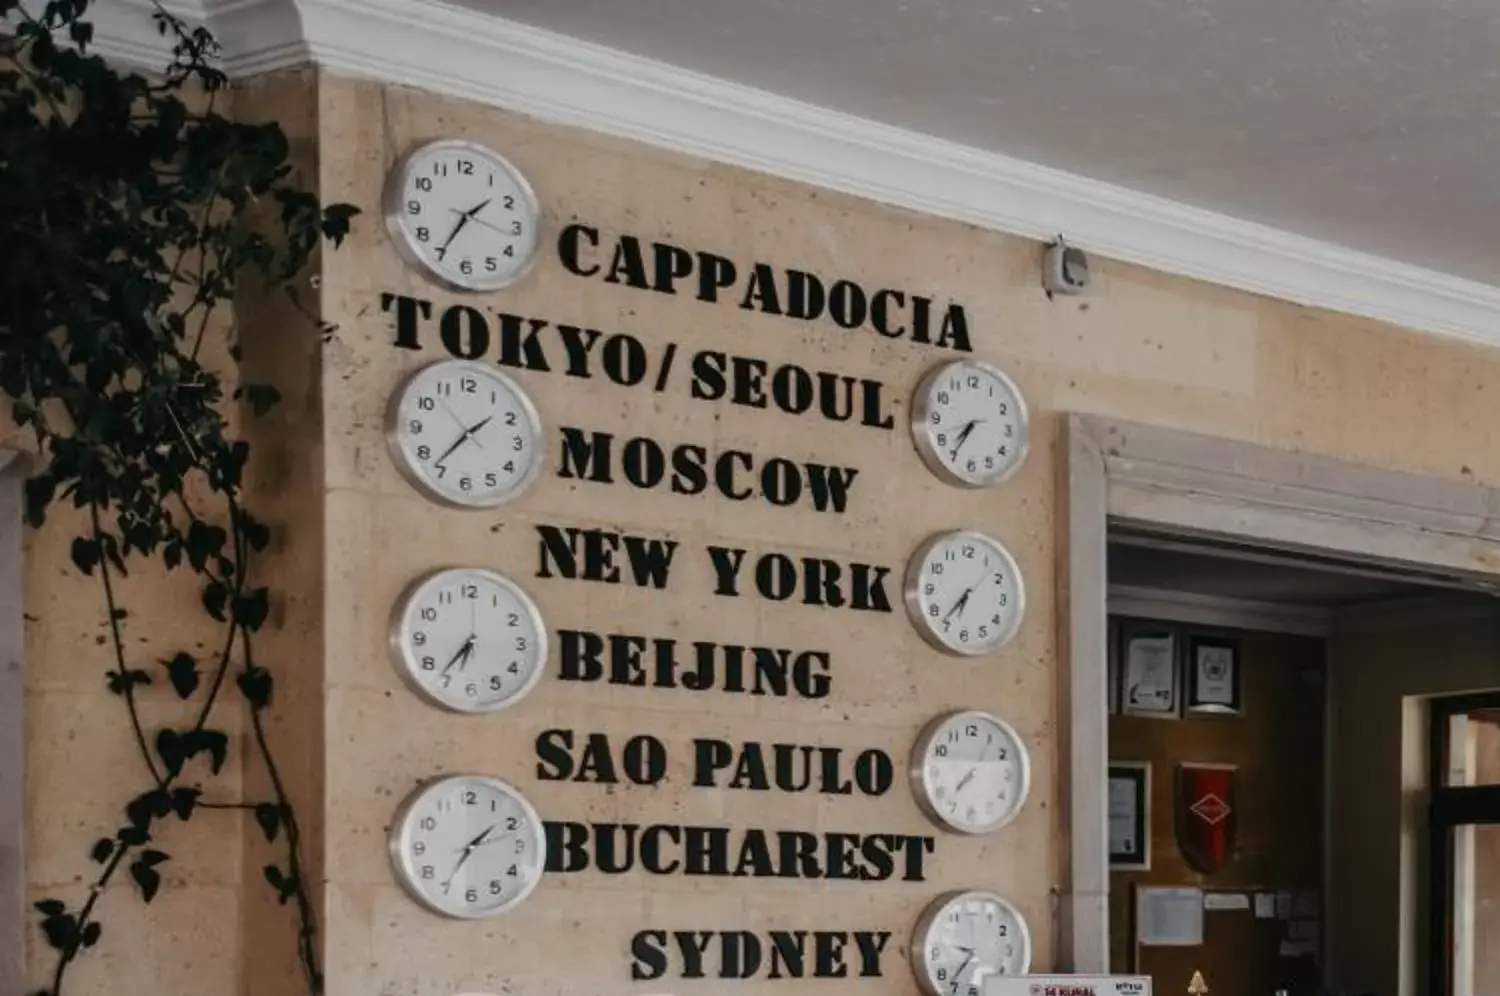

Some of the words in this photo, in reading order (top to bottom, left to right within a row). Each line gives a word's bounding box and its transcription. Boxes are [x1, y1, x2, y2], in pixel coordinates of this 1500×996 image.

[434, 162, 447, 176] 11
[457, 160, 474, 175] 12
[415, 177, 432, 192] 10
[408, 200, 421, 215] 9
[503, 195, 514, 211] 2
[416, 227, 429, 242] 8
[512, 221, 522, 236] 3
[434, 247, 446, 261] 7
[503, 244, 514, 257] 4
[460, 260, 473, 275] 6
[485, 257, 497, 272] 5
[558, 224, 973, 353] CAPPADOCIA
[381, 293, 895, 430] TOKYO/SEOUL
[437, 383, 450, 396] 11
[460, 377, 477, 393] 12
[418, 396, 435, 411] 10
[505, 411, 516, 426] 2
[410, 420, 422, 435] 9
[512, 435, 522, 451] 3
[417, 445, 430, 460] 8
[434, 463, 447, 479] 7
[502, 460, 514, 473] 4
[557, 427, 859, 513] MOSCOW
[460, 477, 472, 490] 6
[485, 473, 497, 487] 5
[535, 526, 679, 590] NEW
[707, 546, 893, 613] YORK
[439, 592, 451, 604] 11
[461, 584, 478, 599] 12
[421, 607, 437, 621] 10
[508, 612, 519, 627] 2
[413, 631, 426, 646] 9
[516, 637, 526, 651] 3
[422, 656, 434, 671] 8
[507, 661, 518, 675] 4
[556, 630, 832, 698] BEIJING
[440, 674, 451, 688] 7
[490, 675, 502, 690] 5
[465, 682, 477, 697] 6
[535, 729, 667, 787] SAO
[692, 738, 894, 797] PAULO
[421, 817, 435, 831] 10
[505, 817, 517, 831] 2
[413, 841, 425, 856] 9
[542, 821, 935, 882] BUCHAREST
[422, 865, 434, 879] 8
[506, 864, 517, 876] 4
[490, 880, 501, 895] 5
[465, 889, 478, 903] 6
[631, 930, 892, 981] SYDNEY
